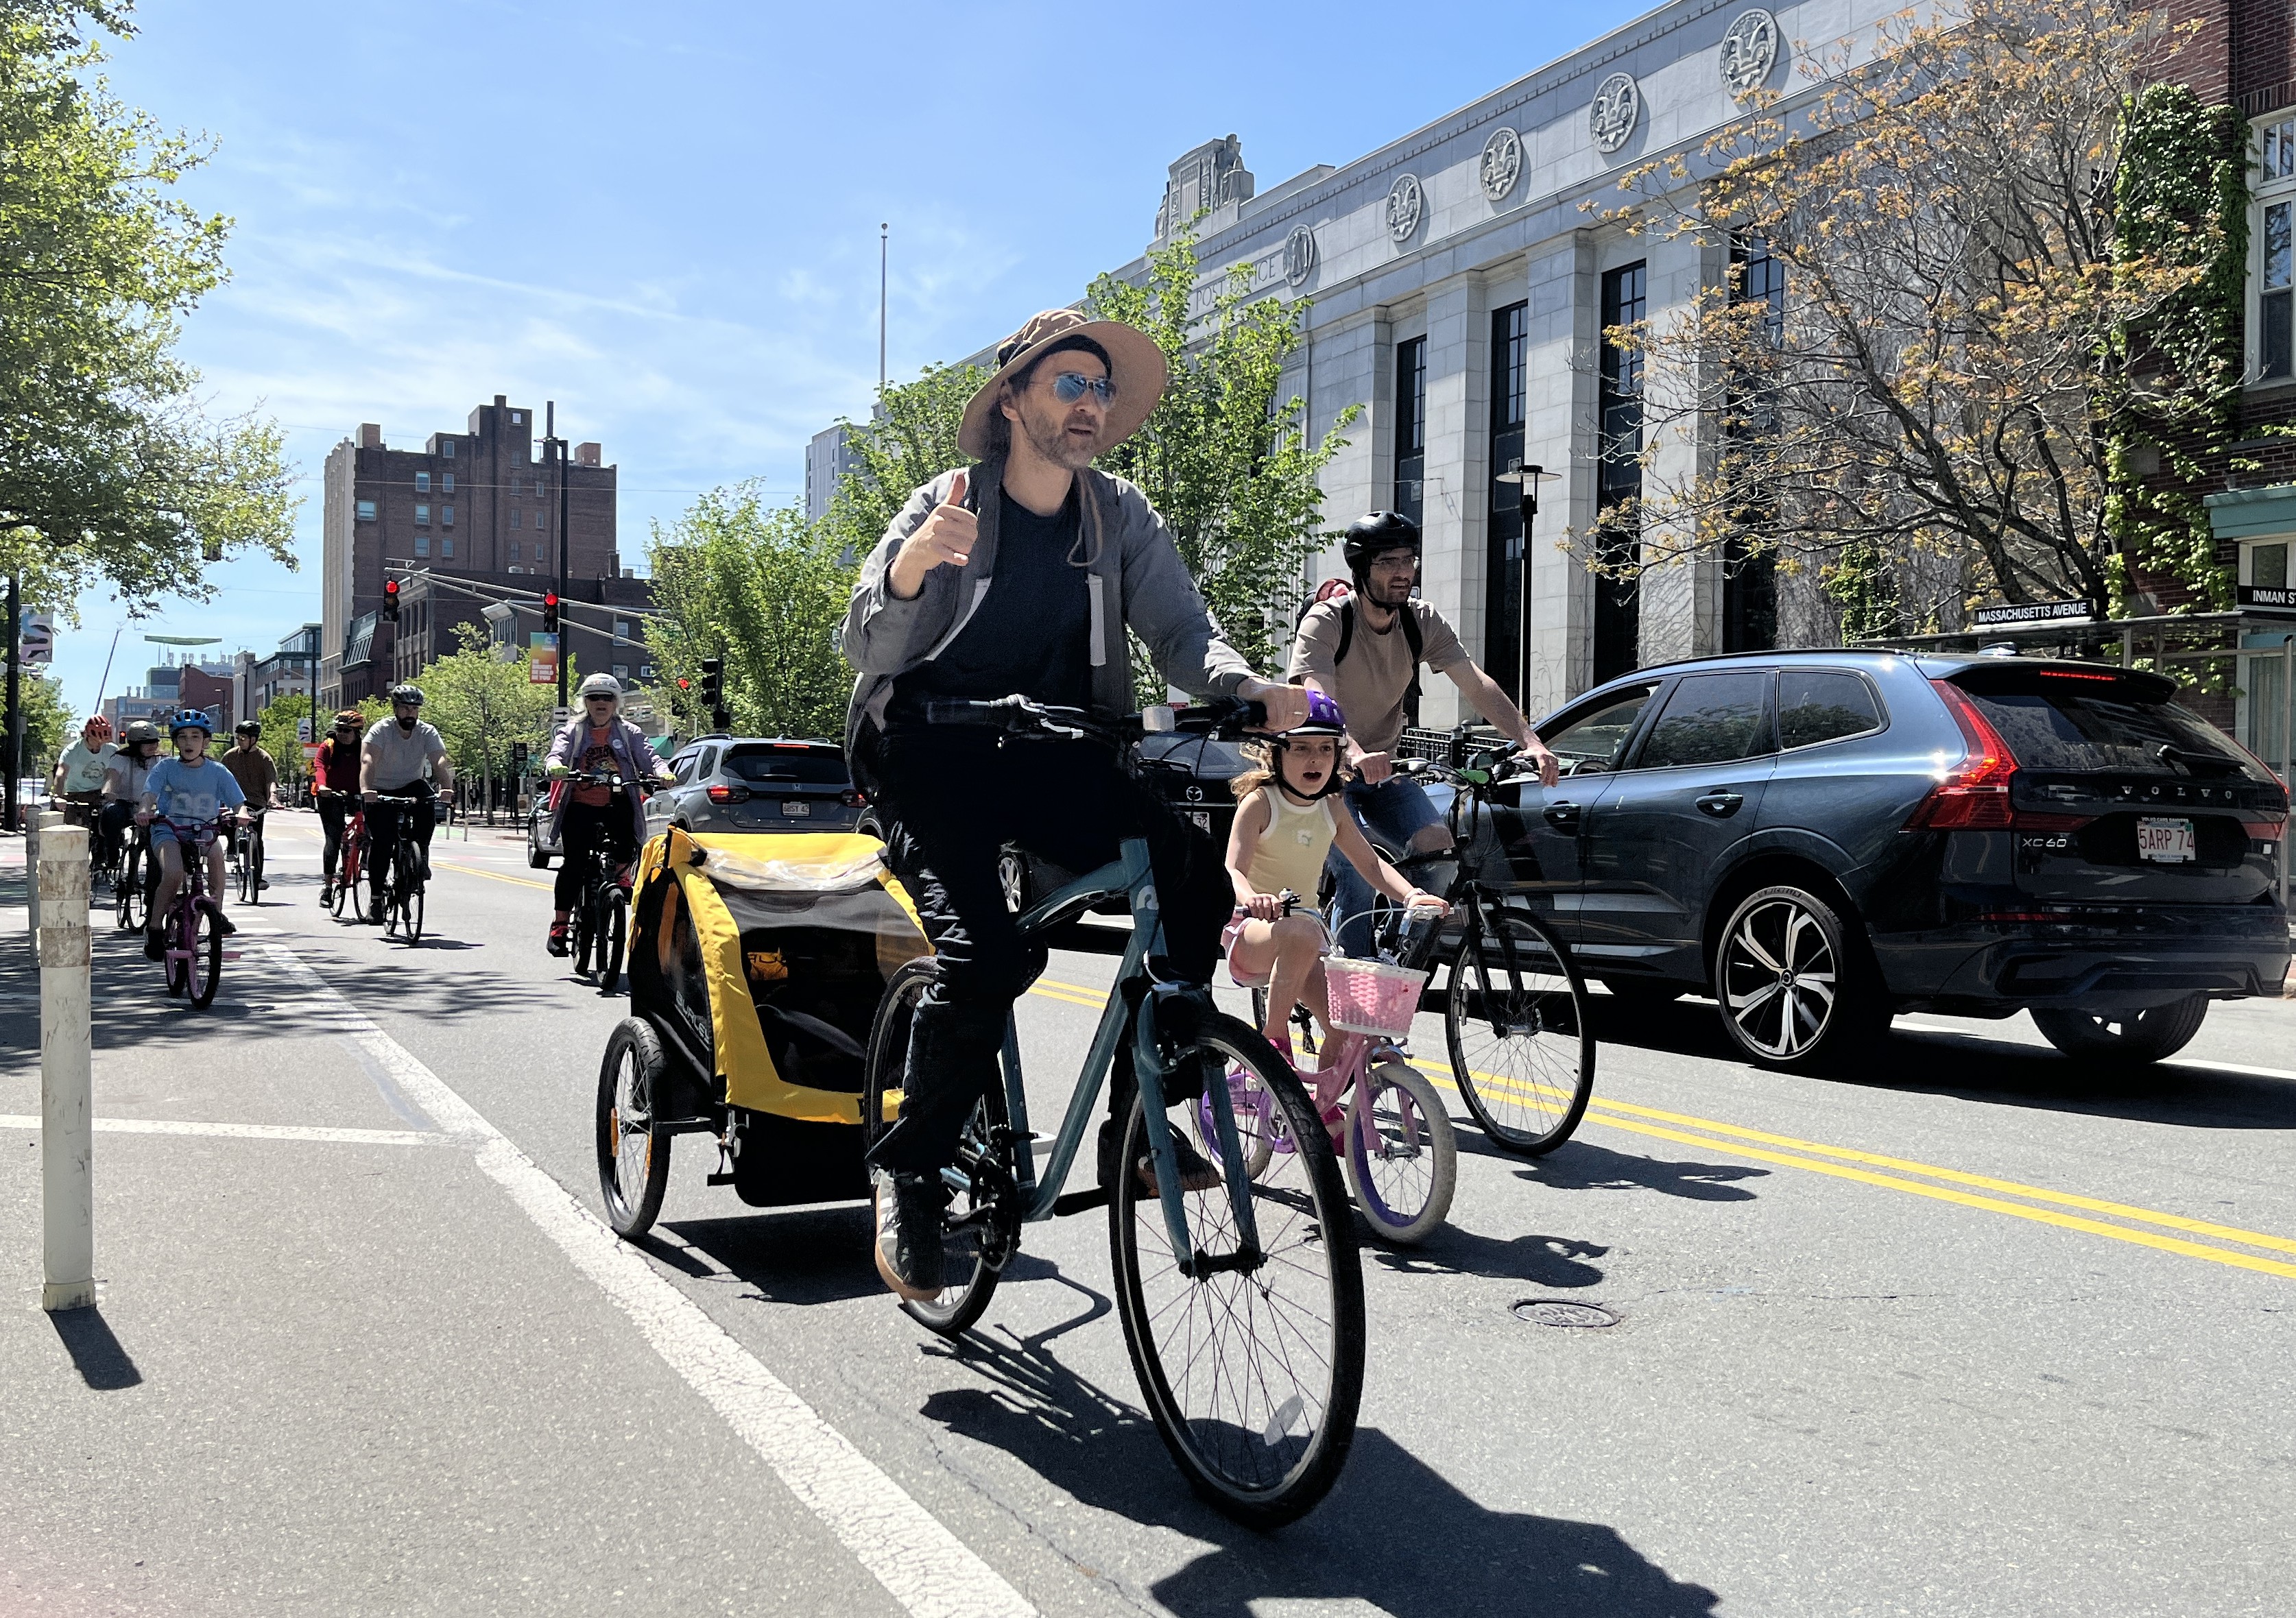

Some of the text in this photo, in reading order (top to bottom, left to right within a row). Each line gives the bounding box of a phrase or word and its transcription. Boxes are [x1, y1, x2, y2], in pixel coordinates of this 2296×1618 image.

[1195, 280, 1225, 311] POST
[2253, 590, 2286, 603] INMAN
[1978, 602, 2087, 623] MASSACHUSETTS AVENUE
[2121, 786, 2232, 800] VOLVO
[2022, 838, 2067, 848] XC60
[2138, 828, 2195, 851] 5ARP 74
